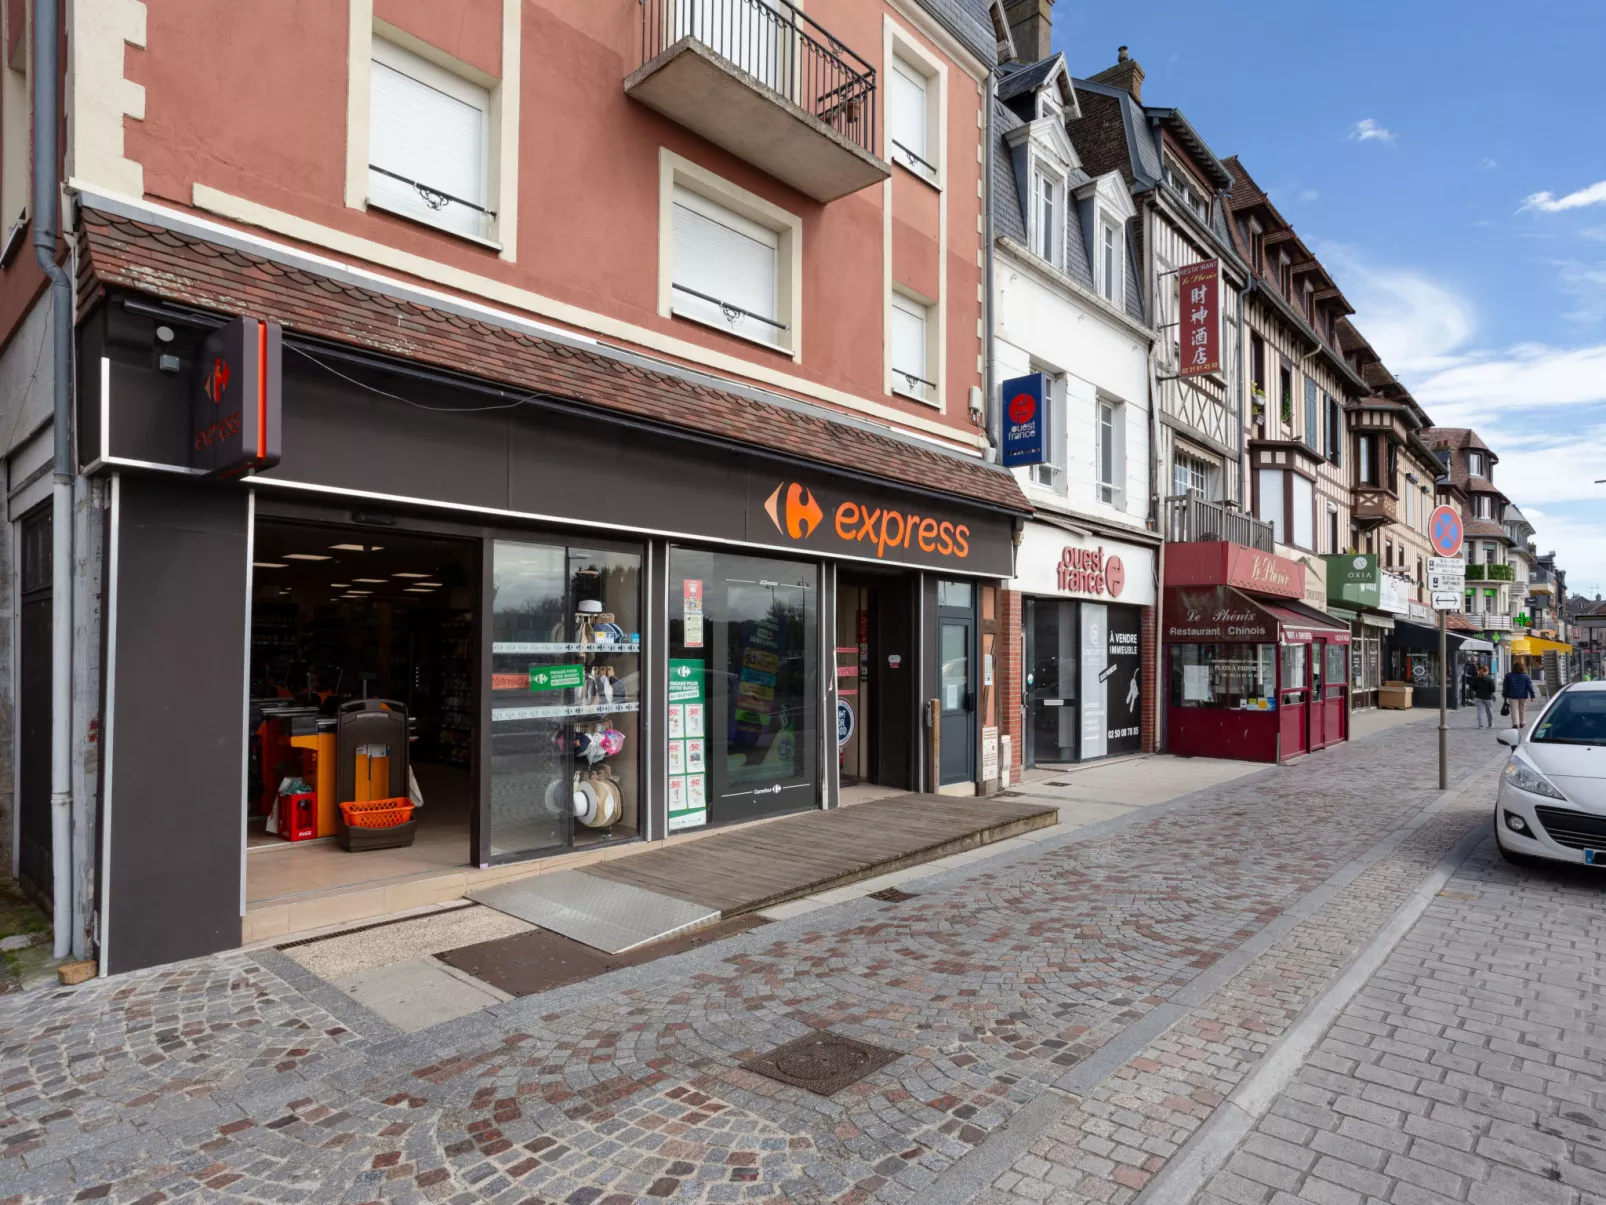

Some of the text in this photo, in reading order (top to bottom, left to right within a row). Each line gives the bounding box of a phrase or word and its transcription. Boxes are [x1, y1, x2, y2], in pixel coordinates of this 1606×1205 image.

[1191, 285, 1208, 365] 財神酒店
[1011, 420, 1036, 433] ouest
[1008, 430, 1036, 441] france
[835, 501, 970, 558] express
[1062, 545, 1104, 573] ouest
[1057, 561, 1105, 595] france
[1186, 608, 1202, 622] Le
[1109, 630, 1138, 644] À VENDRE
[1169, 626, 1266, 636] Restaurant Chinois
[1109, 645, 1138, 655] IMMEUBLE
[1107, 730, 1114, 739] 02
[1114, 729, 1121, 738] 50
